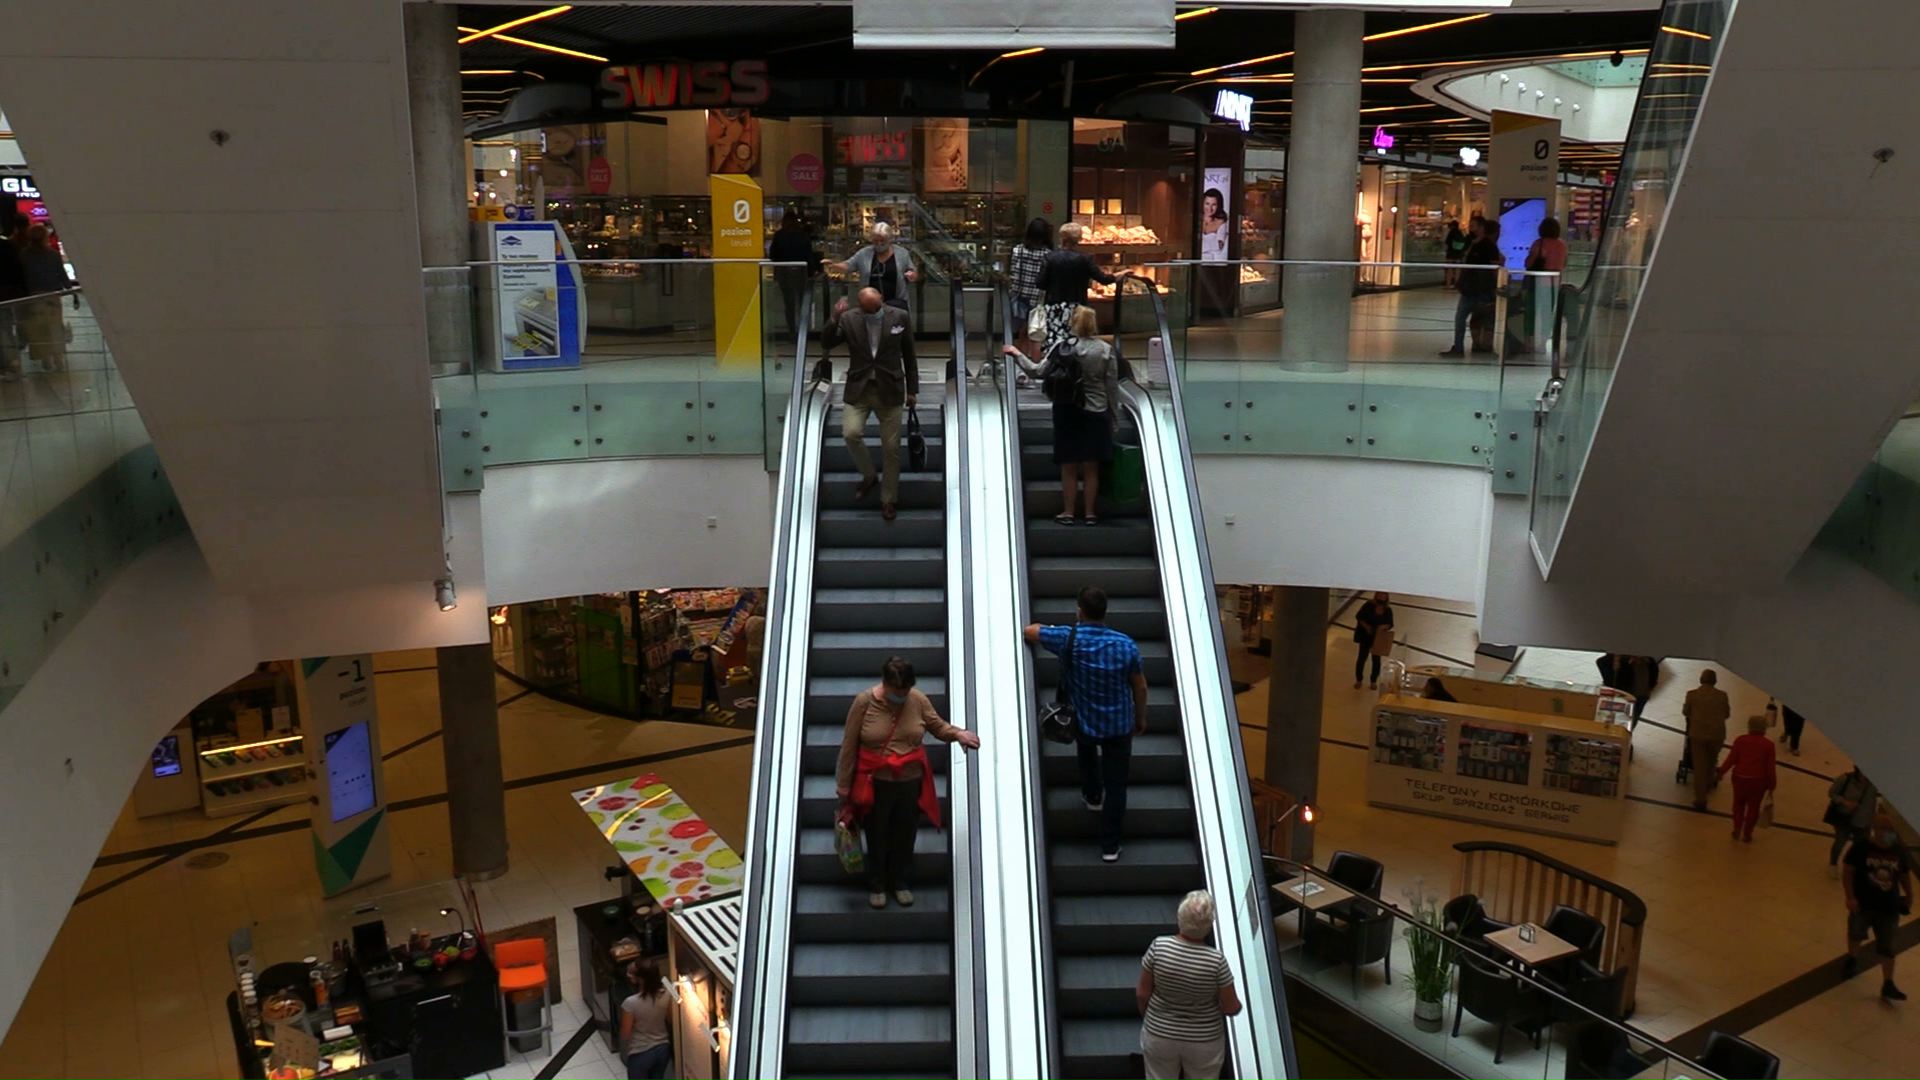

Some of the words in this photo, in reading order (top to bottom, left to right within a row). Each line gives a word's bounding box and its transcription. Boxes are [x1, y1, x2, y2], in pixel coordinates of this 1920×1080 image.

[600, 59, 770, 109] SWISS
[1534, 140, 1550, 160] 0
[0, 178, 36, 193] GL
[791, 171, 818, 181] SALE
[734, 199, 750, 224] 0
[720, 226, 752, 238] poziom
[337, 659, 365, 682] -1
[1405, 778, 1480, 798] TELEFONY
[1412, 790, 1445, 803] SKUP
